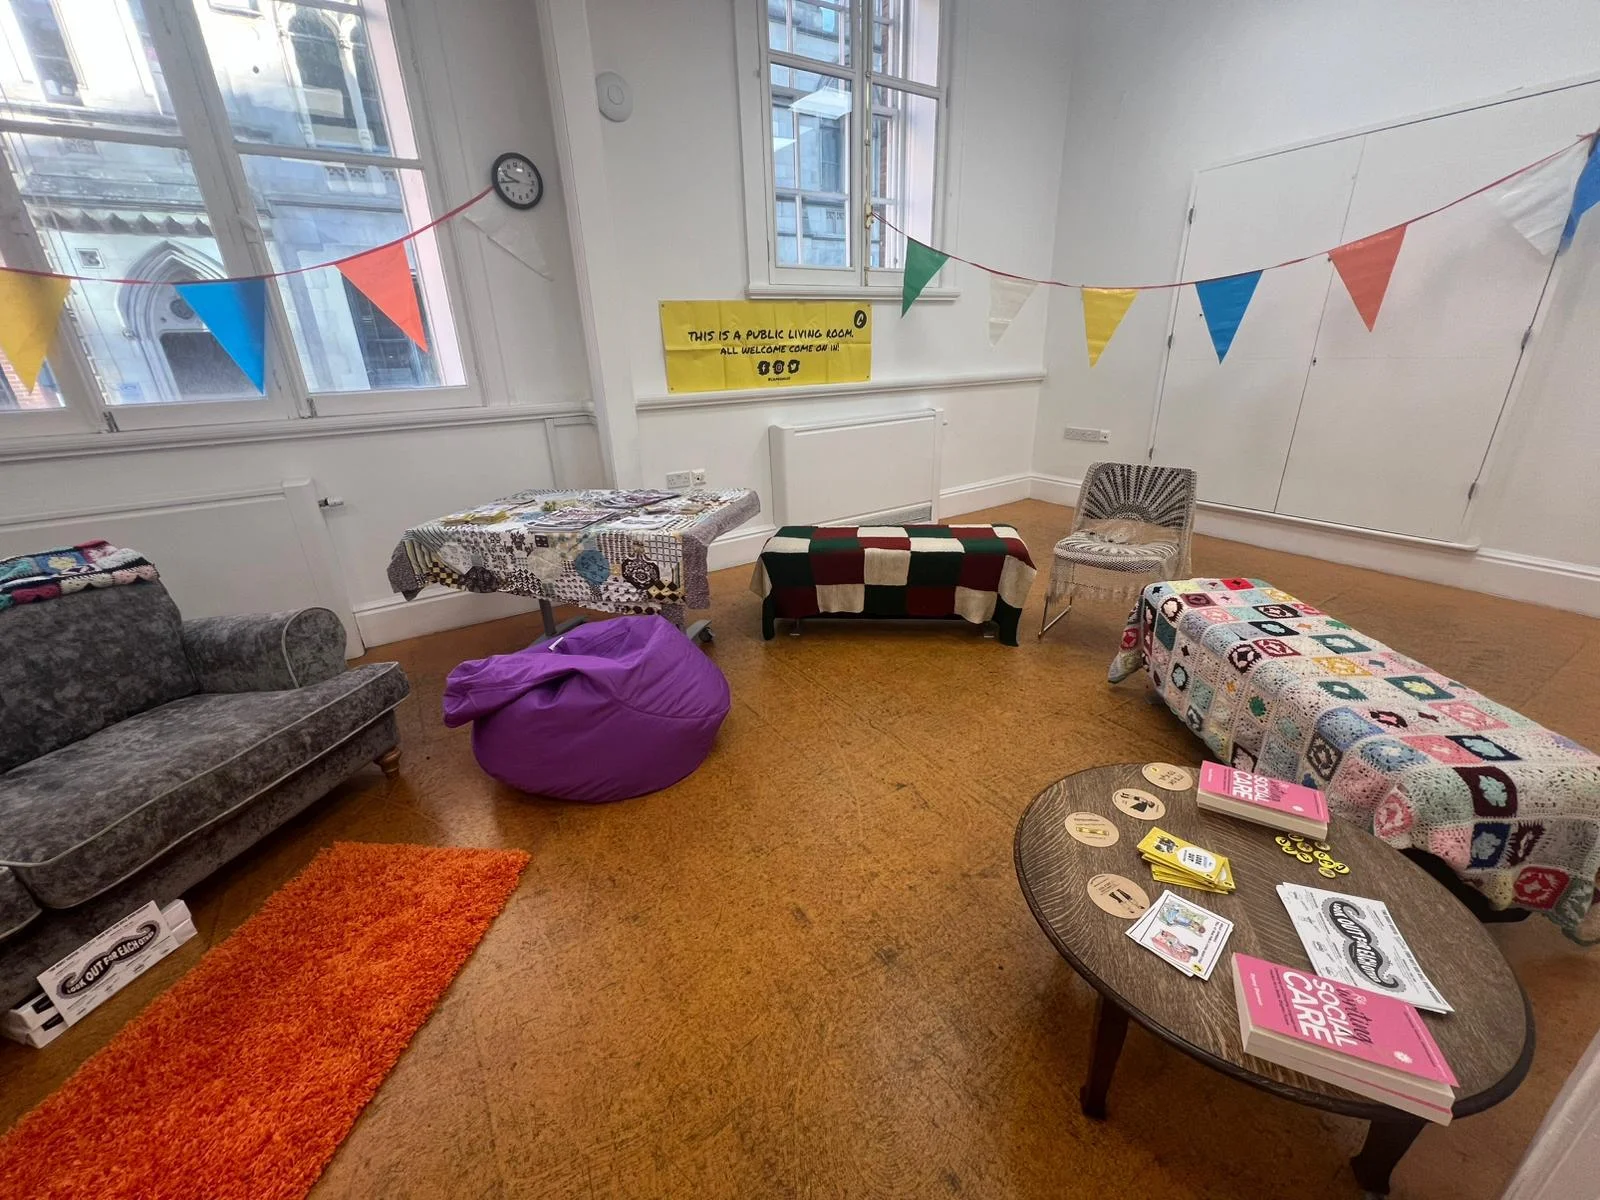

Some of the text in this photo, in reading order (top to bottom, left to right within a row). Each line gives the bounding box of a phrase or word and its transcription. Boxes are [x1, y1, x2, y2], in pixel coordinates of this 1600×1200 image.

[688, 329, 854, 342] THIS IS A PUBLIC LIVING ROOM.
[720, 343, 840, 355] ALL WELCOME COME ON IN!
[1232, 770, 1253, 800] CARE
[1253, 774, 1271, 802] SOCIAL
[1337, 918, 1366, 938] OUT
[1356, 948, 1377, 968] EACH
[67, 979, 87, 994] LOOK
[85, 960, 104, 982] OUT
[103, 951, 119, 966] FOR
[118, 941, 140, 956] EACH
[1282, 971, 1334, 1045] CARE
[1312, 978, 1358, 1047] SOCIAL
